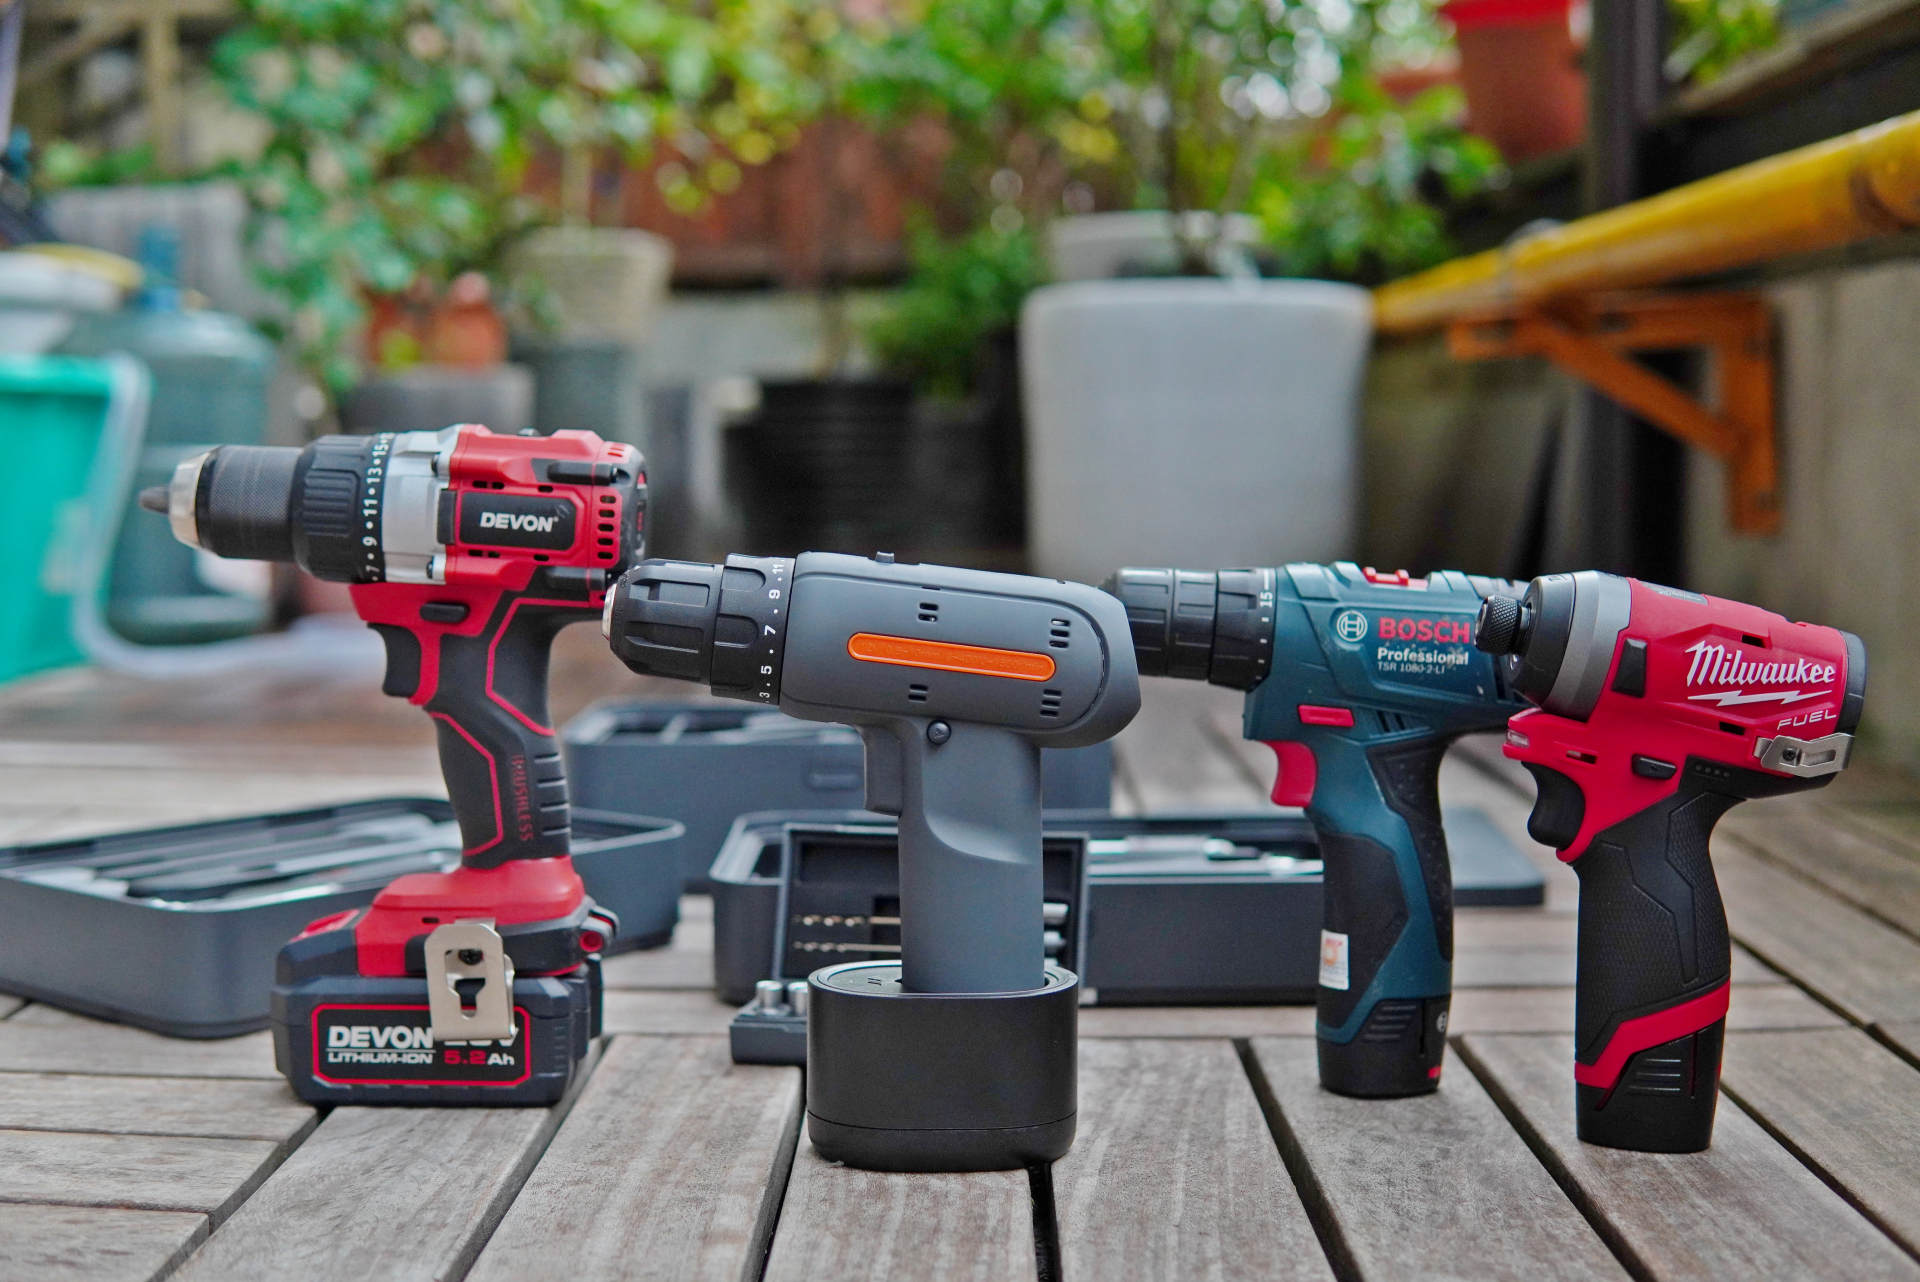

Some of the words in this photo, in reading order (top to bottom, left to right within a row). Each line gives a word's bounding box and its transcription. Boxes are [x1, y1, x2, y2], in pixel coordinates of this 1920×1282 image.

[372, 443, 389, 457] 15
[366, 467, 383, 484] 13
[363, 498, 378, 517] 11
[480, 511, 555, 533] DEVON
[362, 536, 377, 546] 9
[772, 563, 785, 575] 11
[769, 589, 781, 599] 9
[1260, 592, 1273, 608] 15
[764, 624, 776, 636] 7
[1378, 617, 1471, 644] BOSCH
[1377, 647, 1469, 665] Professional
[1685, 639, 1836, 687] Milwaukee
[761, 665, 772, 675] 5
[1378, 661, 1397, 672] TSR
[759, 691, 770, 699] 3
[1776, 709, 1837, 730] FUEL
[328, 1025, 434, 1049] DEVON
[328, 1052, 433, 1064] LITHIUM-ION
